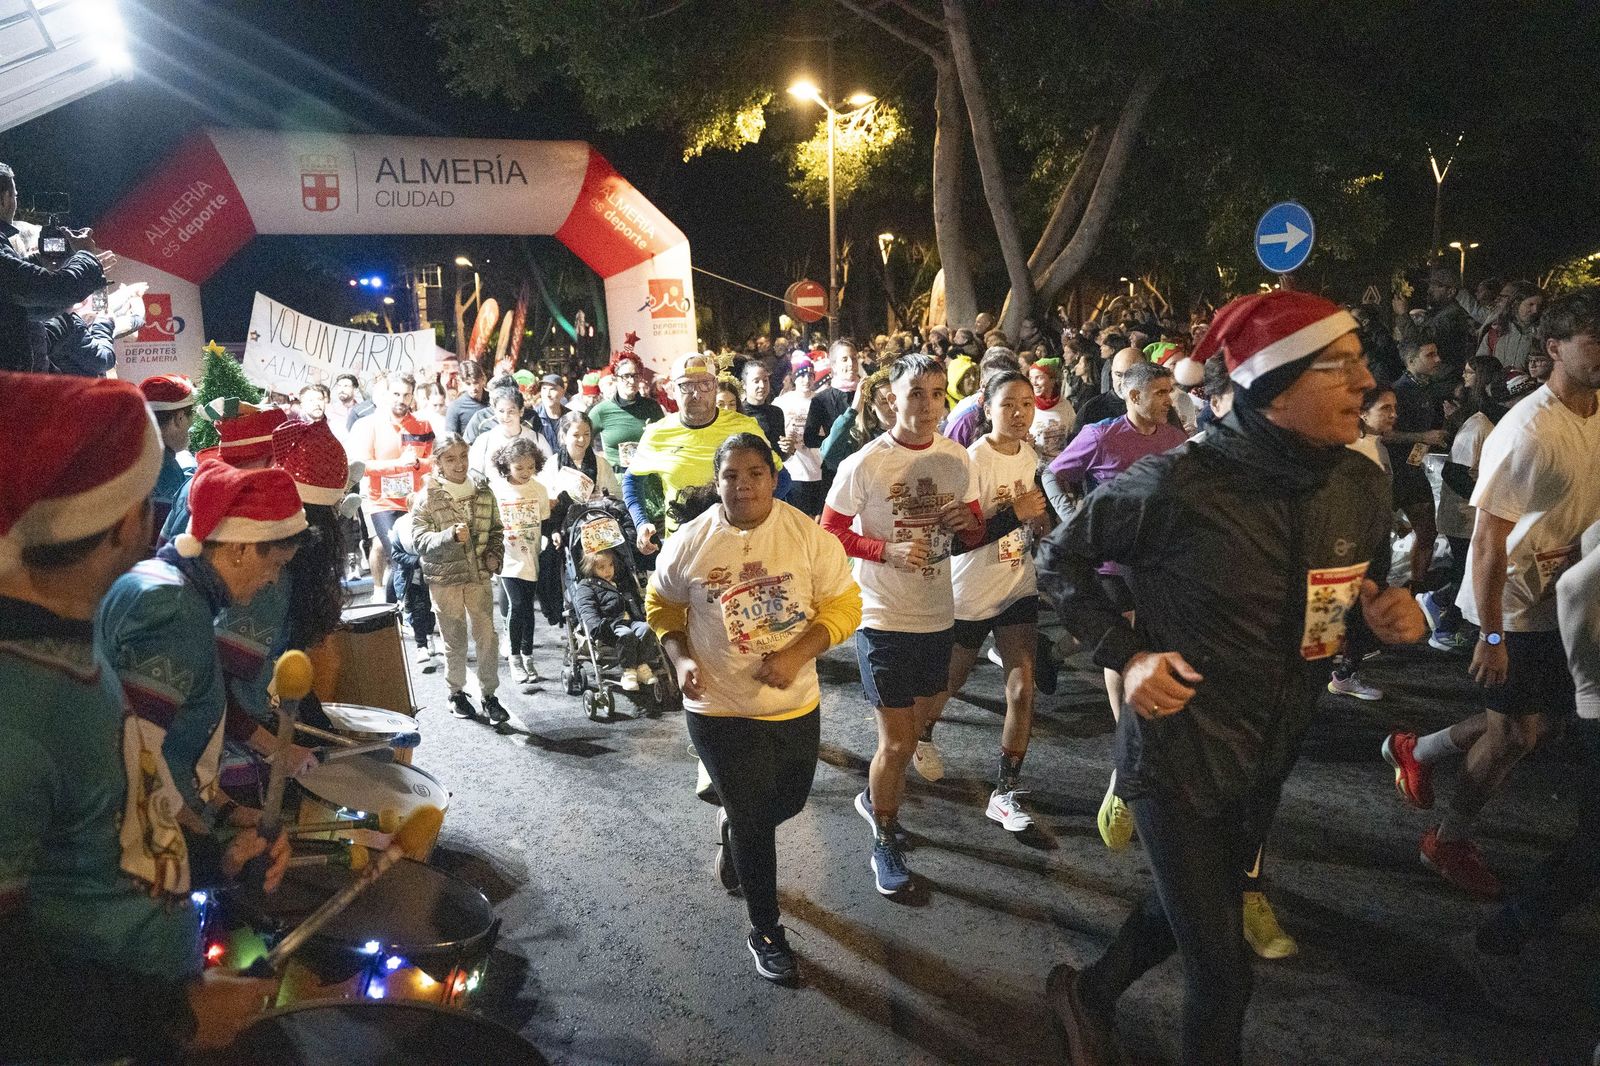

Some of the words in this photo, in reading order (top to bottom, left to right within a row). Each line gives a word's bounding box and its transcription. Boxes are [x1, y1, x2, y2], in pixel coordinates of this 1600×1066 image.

[375, 154, 528, 185] ALMERÍA
[375, 189, 455, 208] CIUDAD
[144, 180, 213, 246] ALMERÍA
[162, 240, 180, 258] es
[178, 194, 228, 242] deporte
[589, 198, 604, 213] es
[603, 209, 648, 250] deporte
[125, 347, 177, 356] DEPORTES
[125, 356, 138, 364] DE
[140, 355, 178, 363] ALMERIA
[741, 598, 784, 620] 1076
